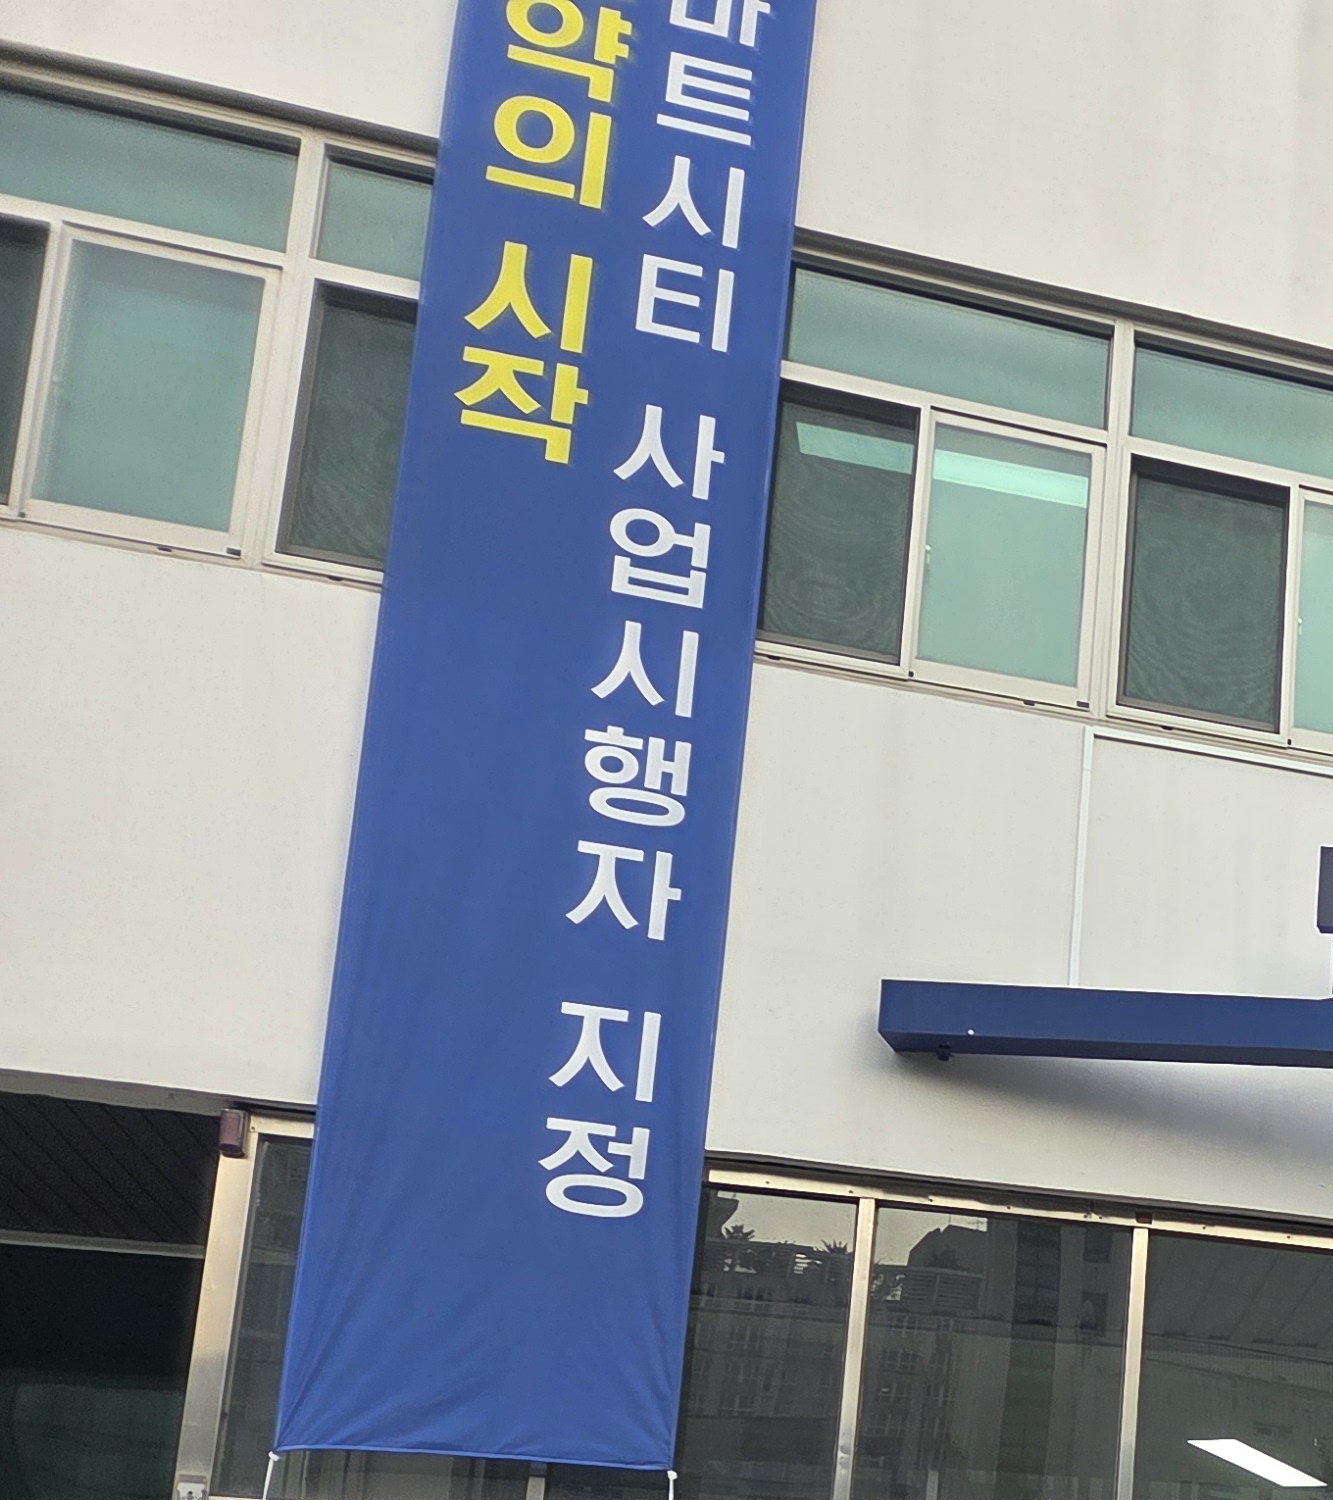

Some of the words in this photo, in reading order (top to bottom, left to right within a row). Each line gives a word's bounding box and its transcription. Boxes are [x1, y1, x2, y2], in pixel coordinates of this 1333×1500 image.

[485, 0, 633, 210] 약의
[454, 242, 592, 464] 시작
[564, 404, 726, 941] 사업시행자
[537, 1001, 662, 1219] 지정
